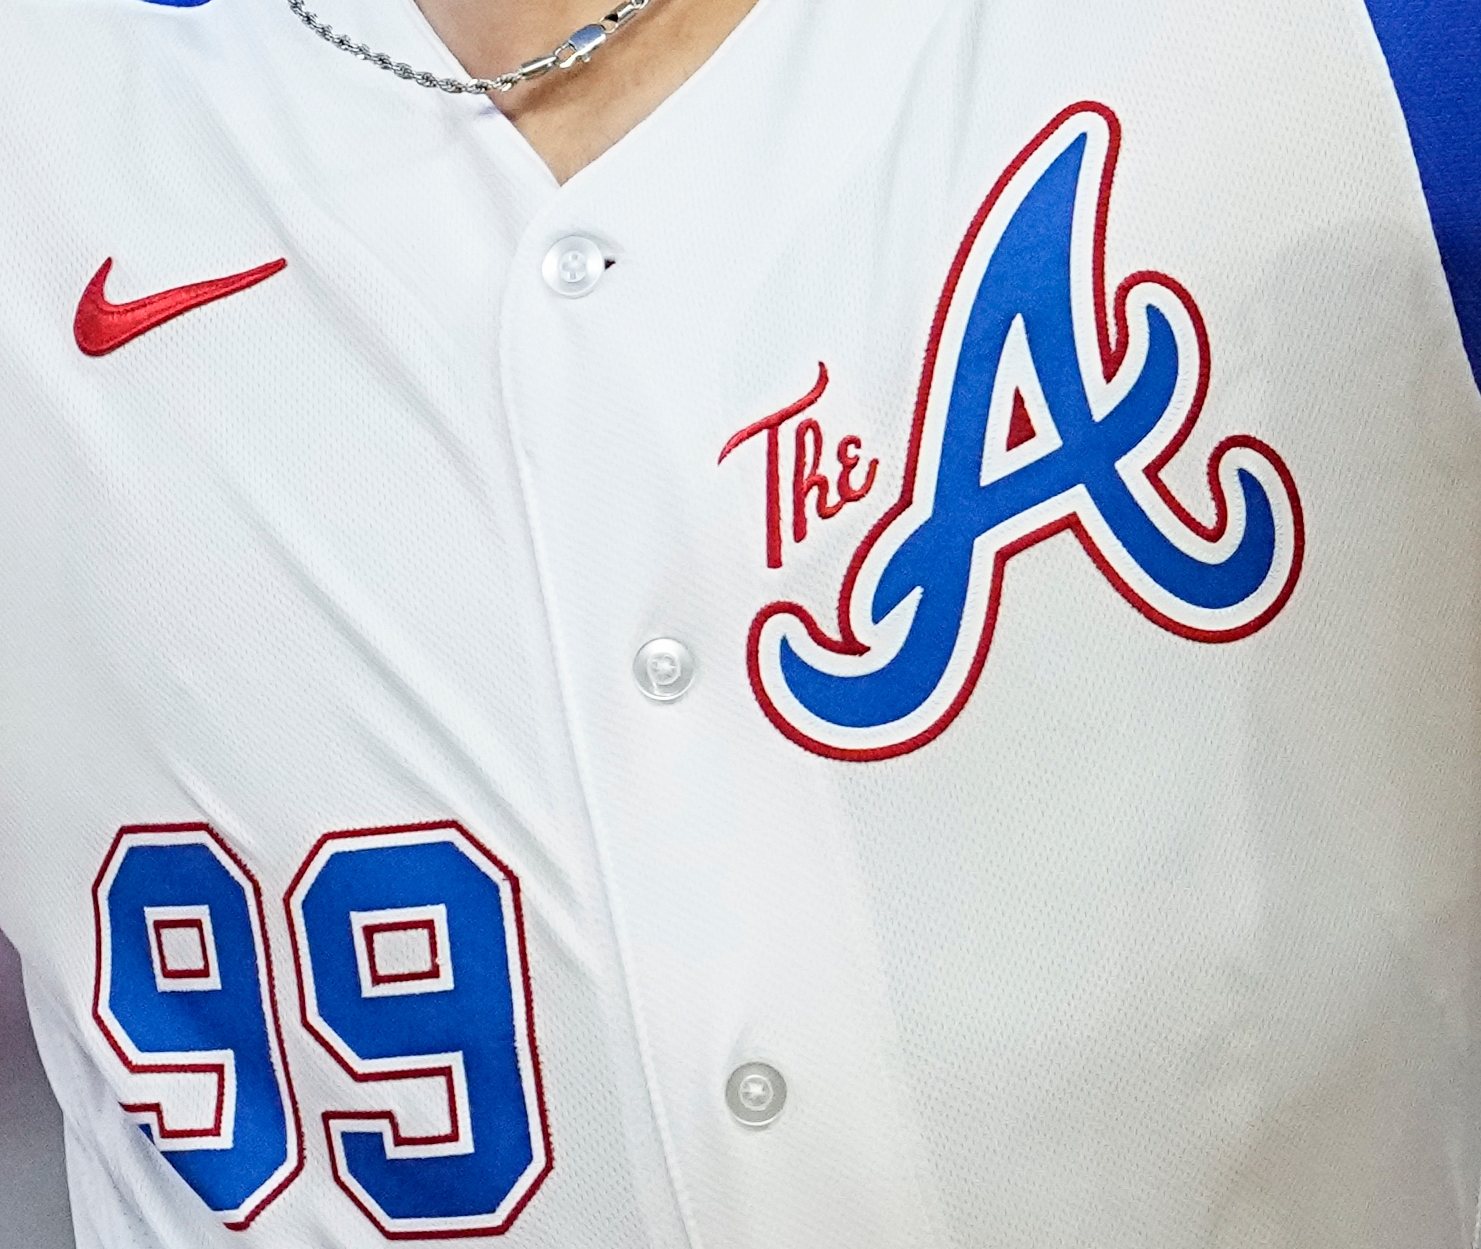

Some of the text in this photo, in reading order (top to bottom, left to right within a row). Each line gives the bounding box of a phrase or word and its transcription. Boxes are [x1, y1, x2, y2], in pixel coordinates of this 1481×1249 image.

[718, 100, 1305, 762] The A
[92, 820, 555, 1241] 99
